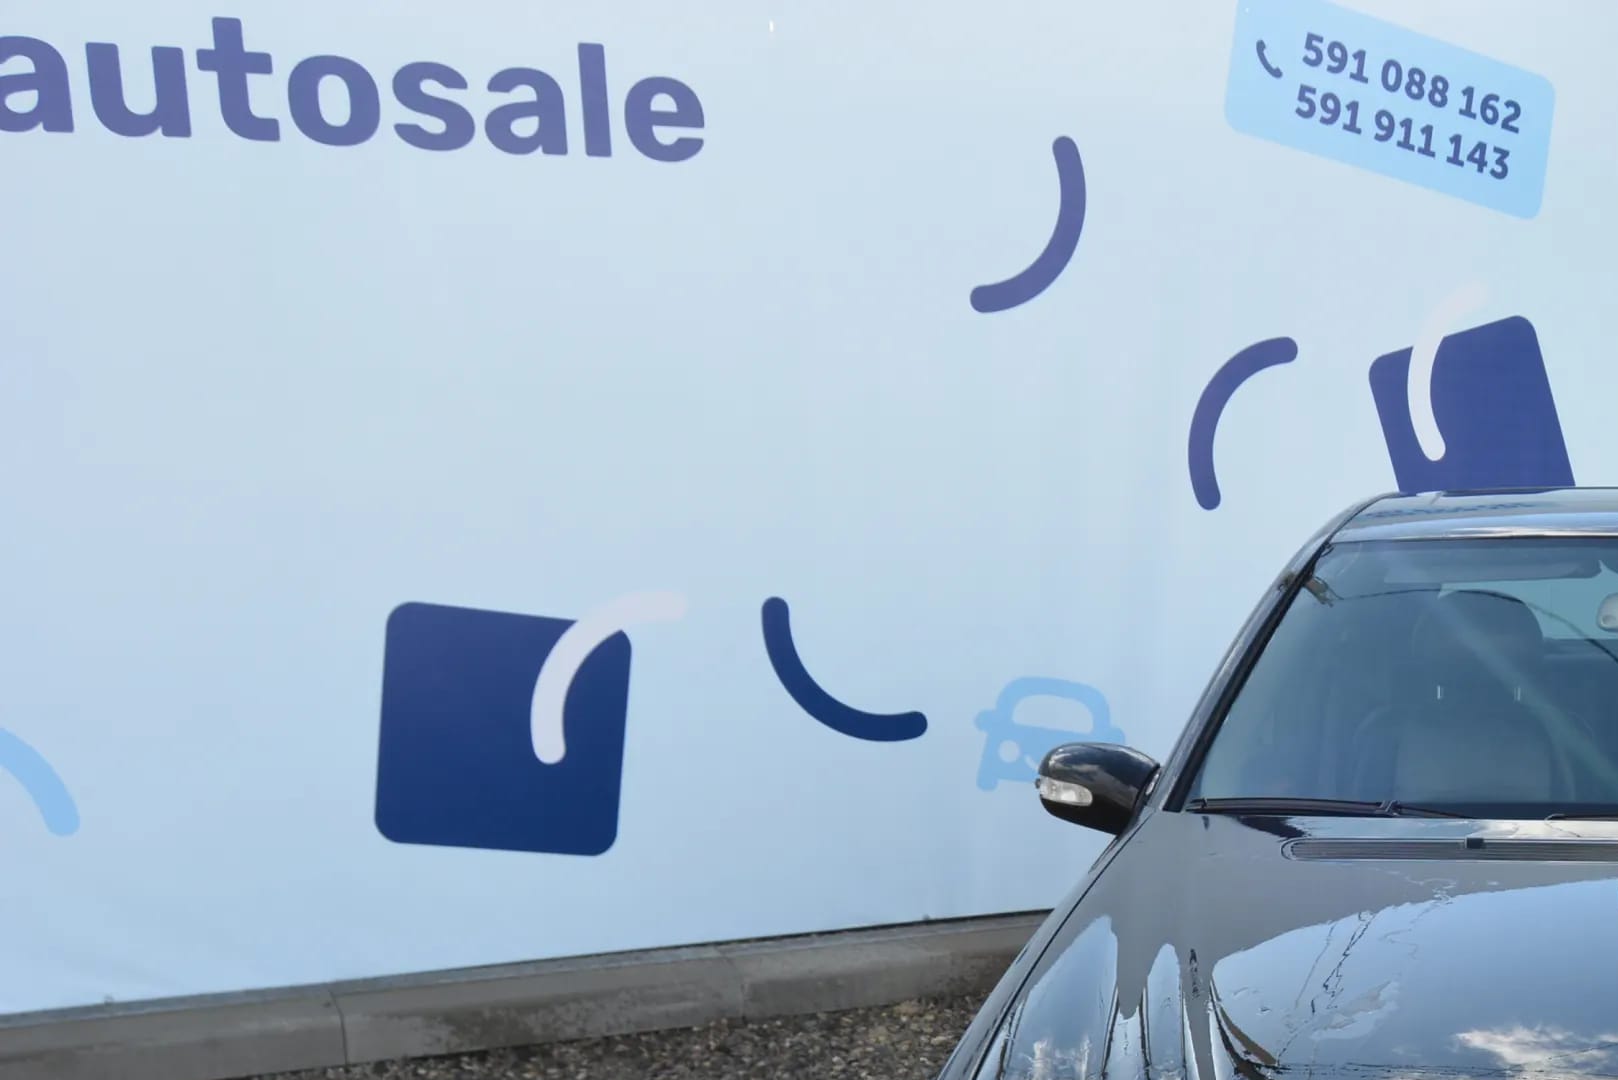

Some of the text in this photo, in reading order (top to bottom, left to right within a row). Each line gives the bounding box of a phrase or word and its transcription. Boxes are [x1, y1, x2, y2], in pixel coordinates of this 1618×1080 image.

[0, 17, 705, 163] autosale
[1295, 83, 1511, 180] 591 911 143
[1302, 32, 1522, 134] 591 088 162
